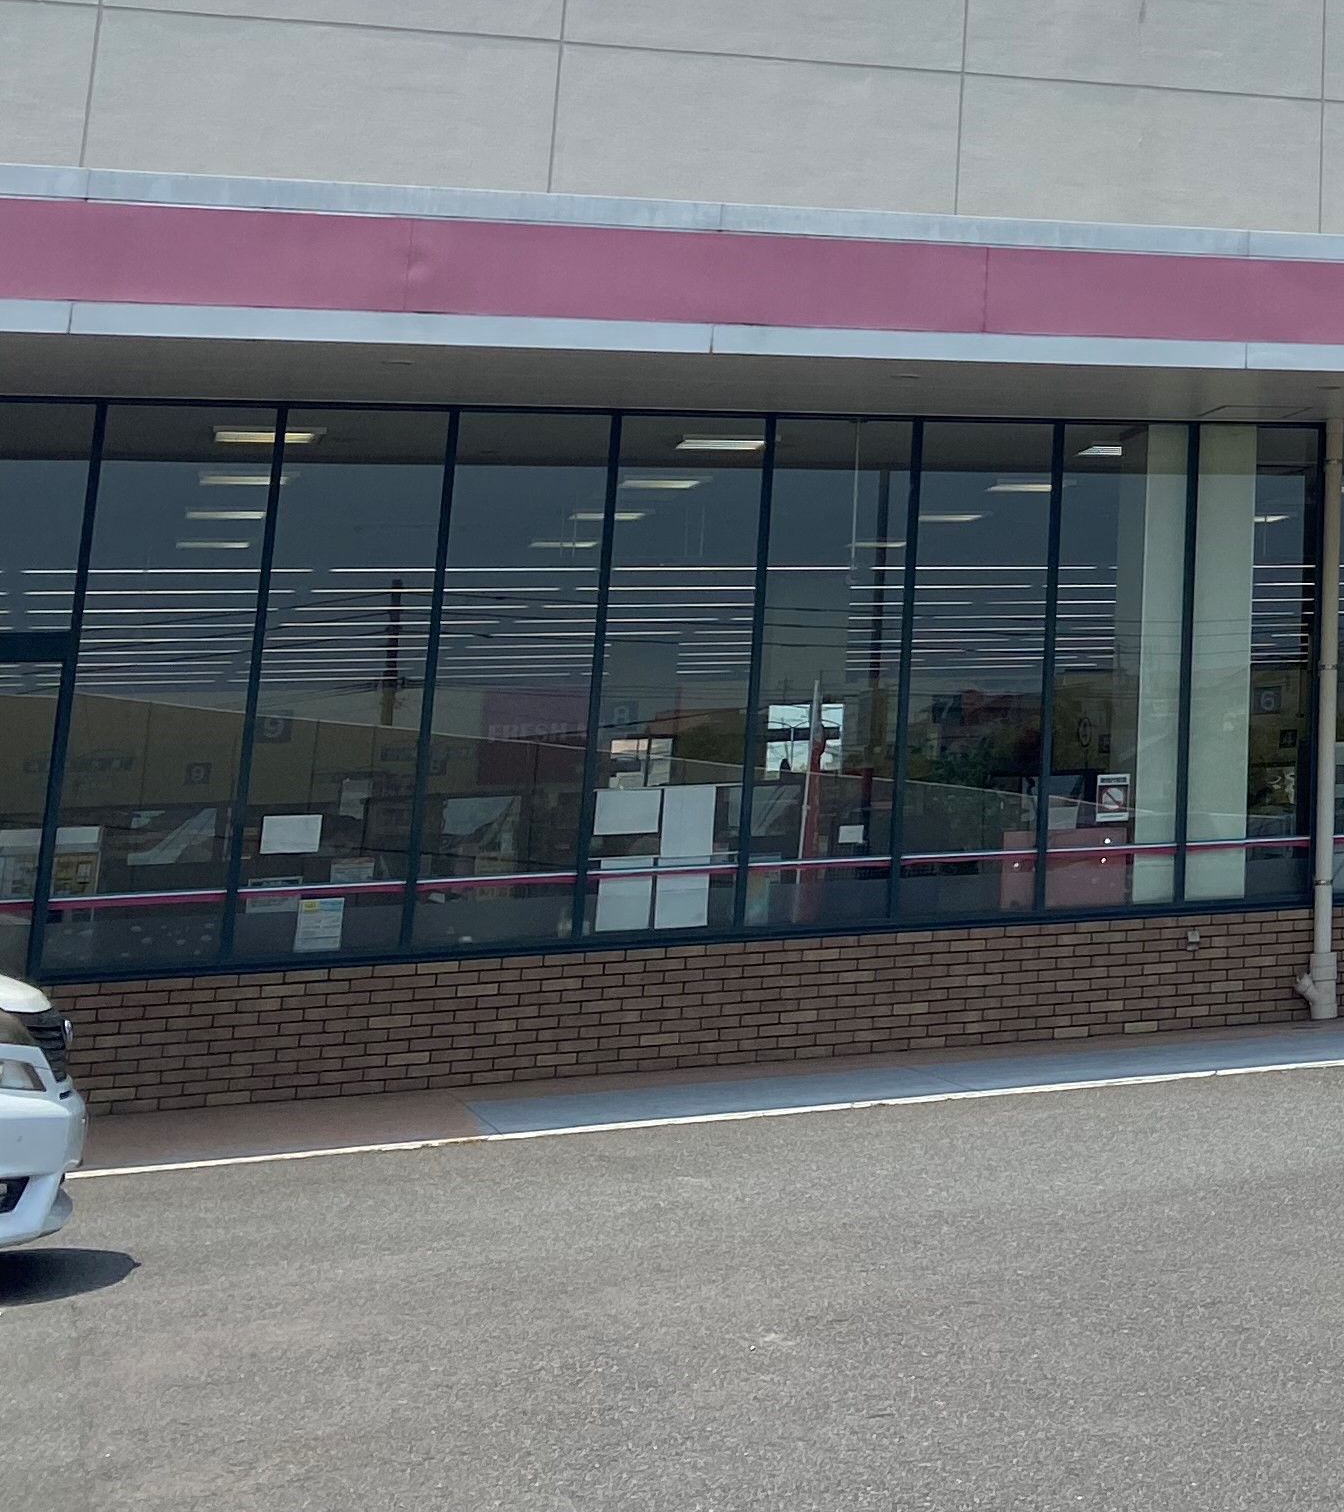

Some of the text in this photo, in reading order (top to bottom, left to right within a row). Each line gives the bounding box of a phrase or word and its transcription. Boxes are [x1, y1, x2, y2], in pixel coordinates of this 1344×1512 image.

[1260, 691, 1275, 711] 6
[262, 717, 284, 738] 9
[192, 766, 206, 782] 9
